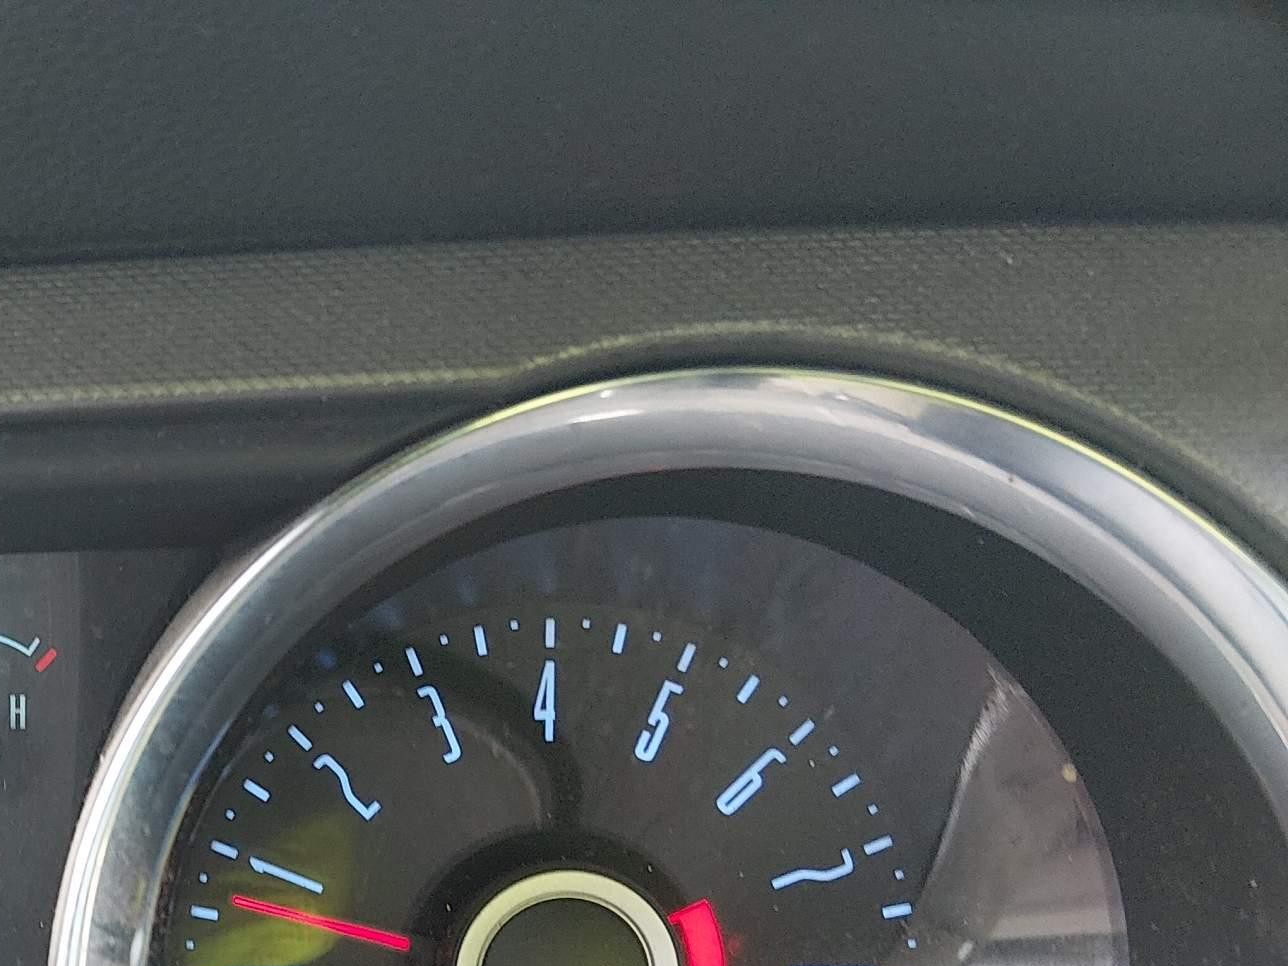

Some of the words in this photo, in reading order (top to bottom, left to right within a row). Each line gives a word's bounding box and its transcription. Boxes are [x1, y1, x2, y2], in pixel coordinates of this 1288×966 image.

[8, 693, 27, 731] H
[419, 686, 462, 763] 3
[534, 662, 556, 741] 4
[636, 680, 684, 762] 5
[314, 754, 382, 821] 2
[716, 748, 786, 815] 6
[249, 857, 323, 893] 1
[771, 849, 854, 889] 7
